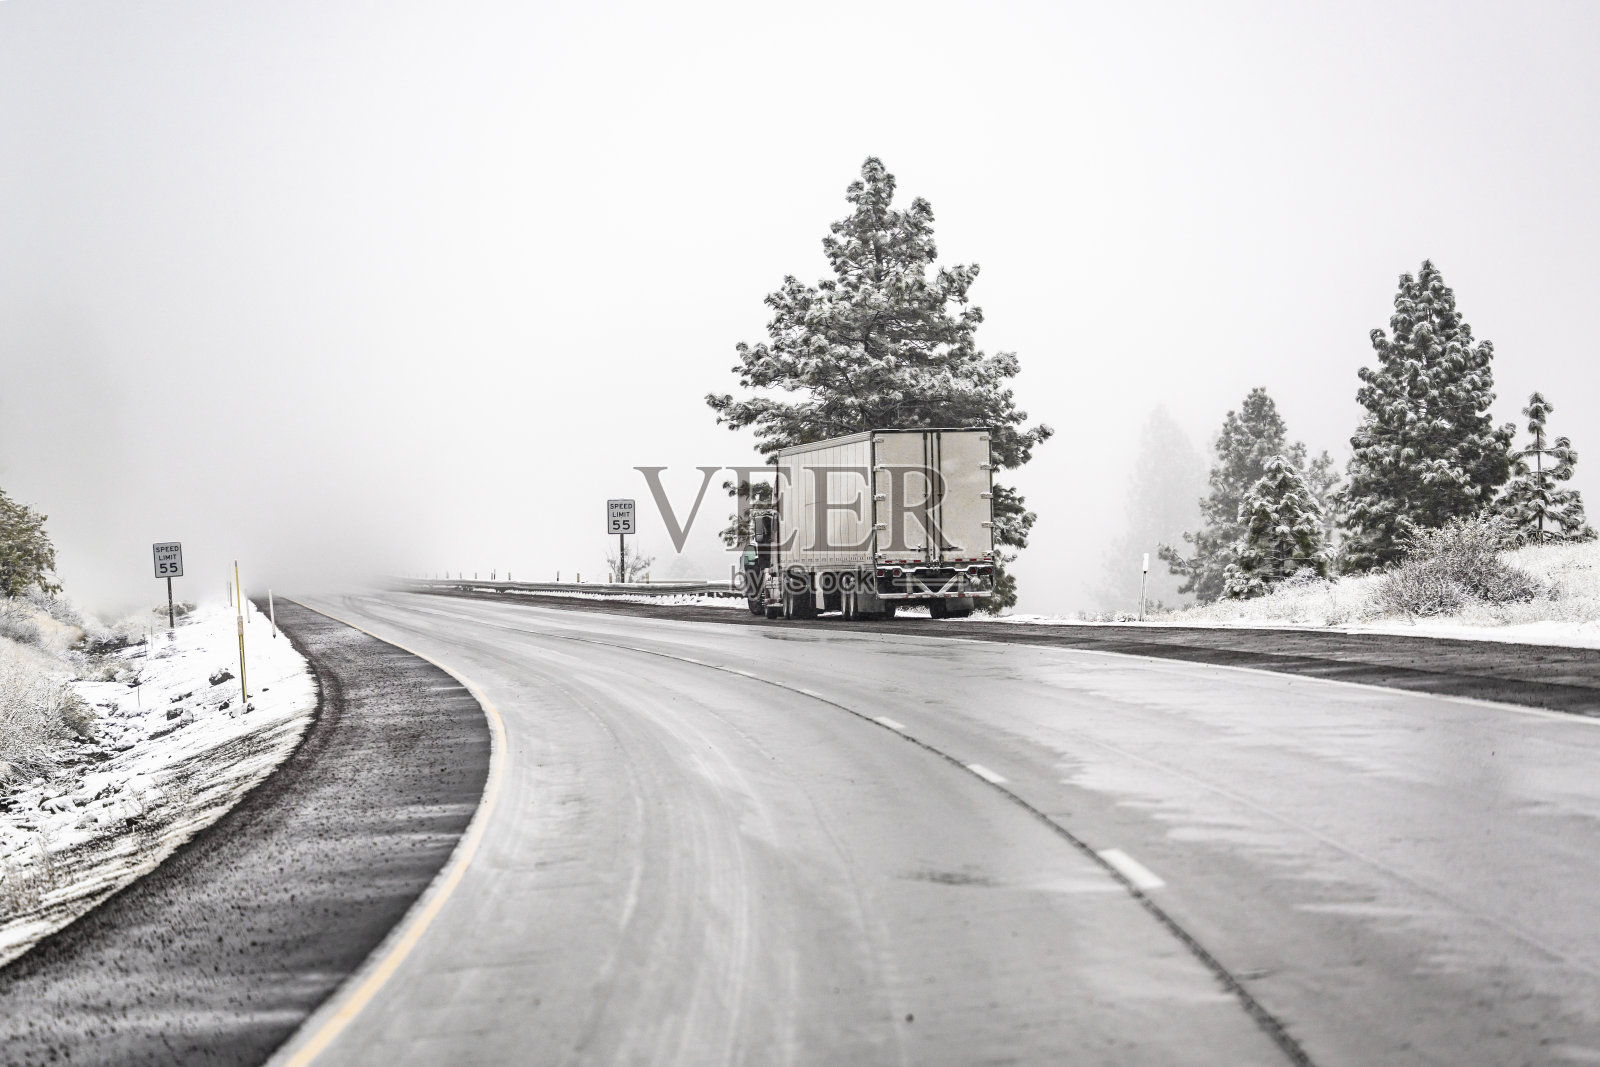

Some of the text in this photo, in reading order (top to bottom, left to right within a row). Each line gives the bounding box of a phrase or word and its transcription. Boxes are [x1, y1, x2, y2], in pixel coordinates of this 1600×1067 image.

[612, 519, 631, 530] 55
[155, 545, 180, 553] SPEED
[160, 562, 178, 574] 55
